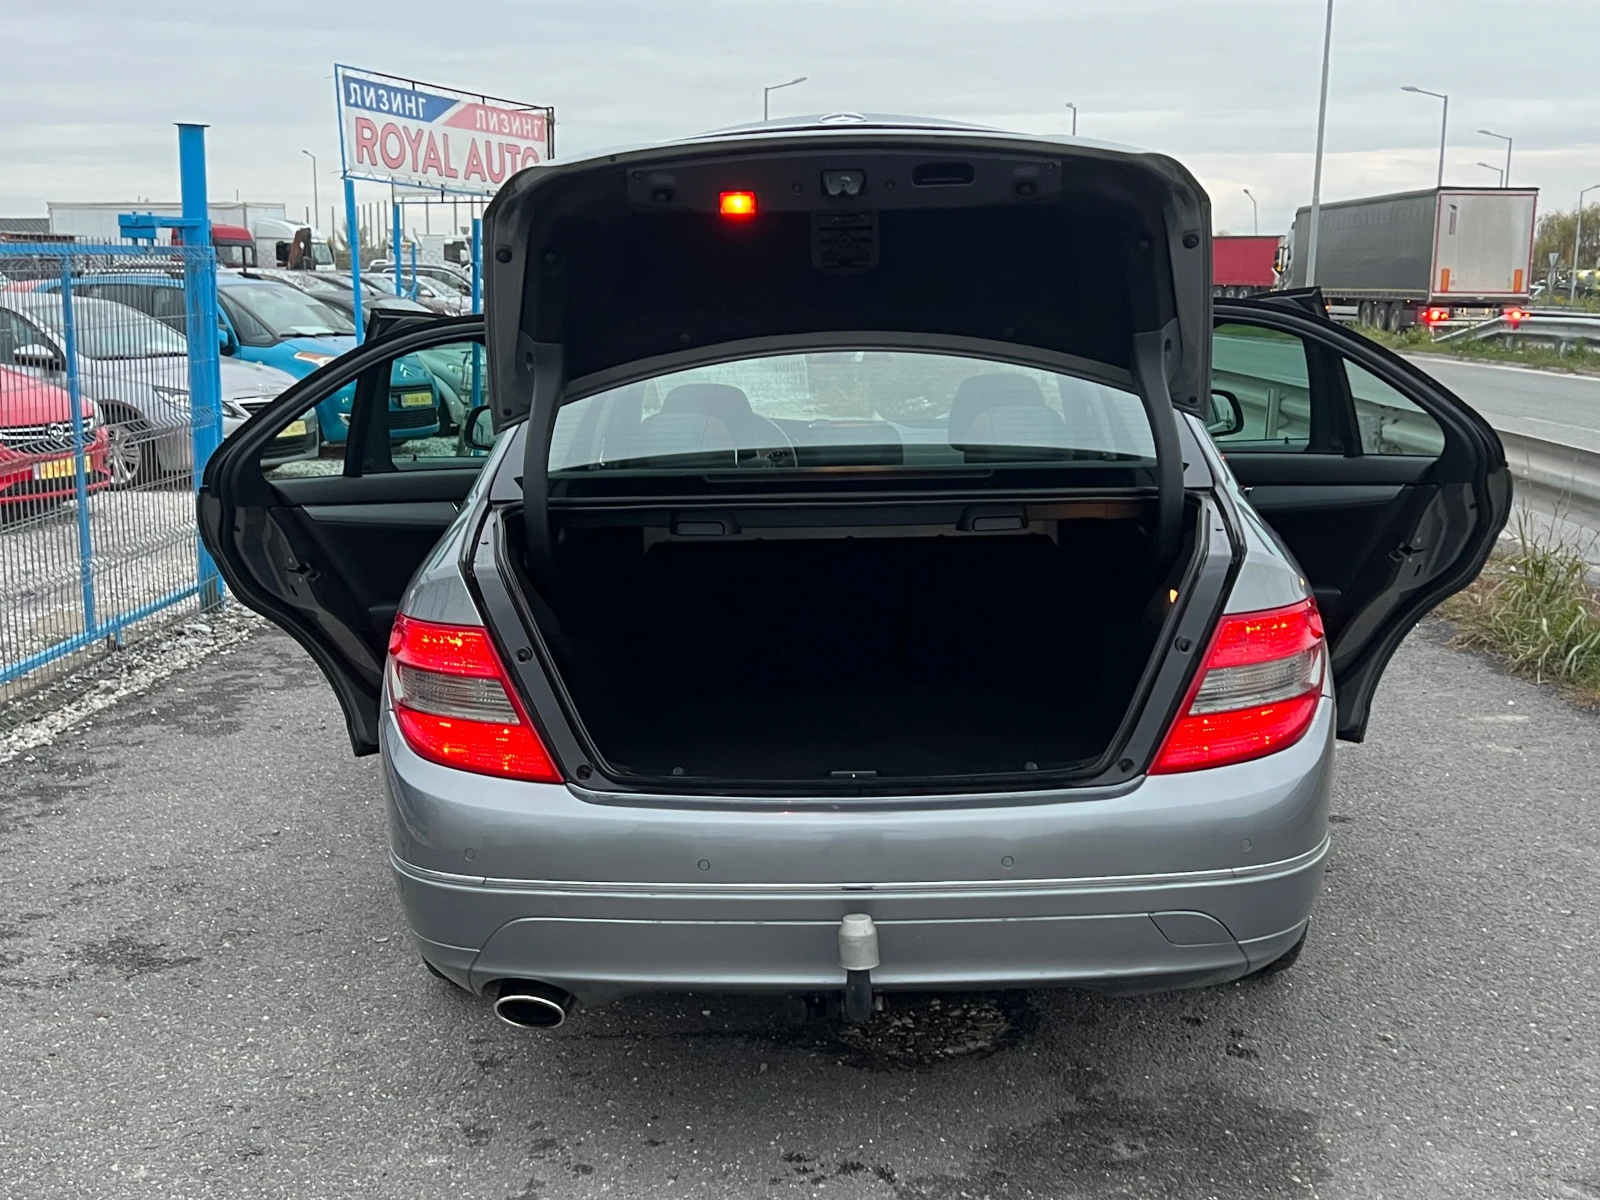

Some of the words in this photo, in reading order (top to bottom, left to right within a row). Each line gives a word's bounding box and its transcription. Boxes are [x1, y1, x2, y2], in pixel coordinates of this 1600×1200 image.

[349, 82, 426, 118] ЛИЗИНГ
[475, 108, 542, 138] ЛИЗИНГ
[355, 116, 458, 179] ROYAL
